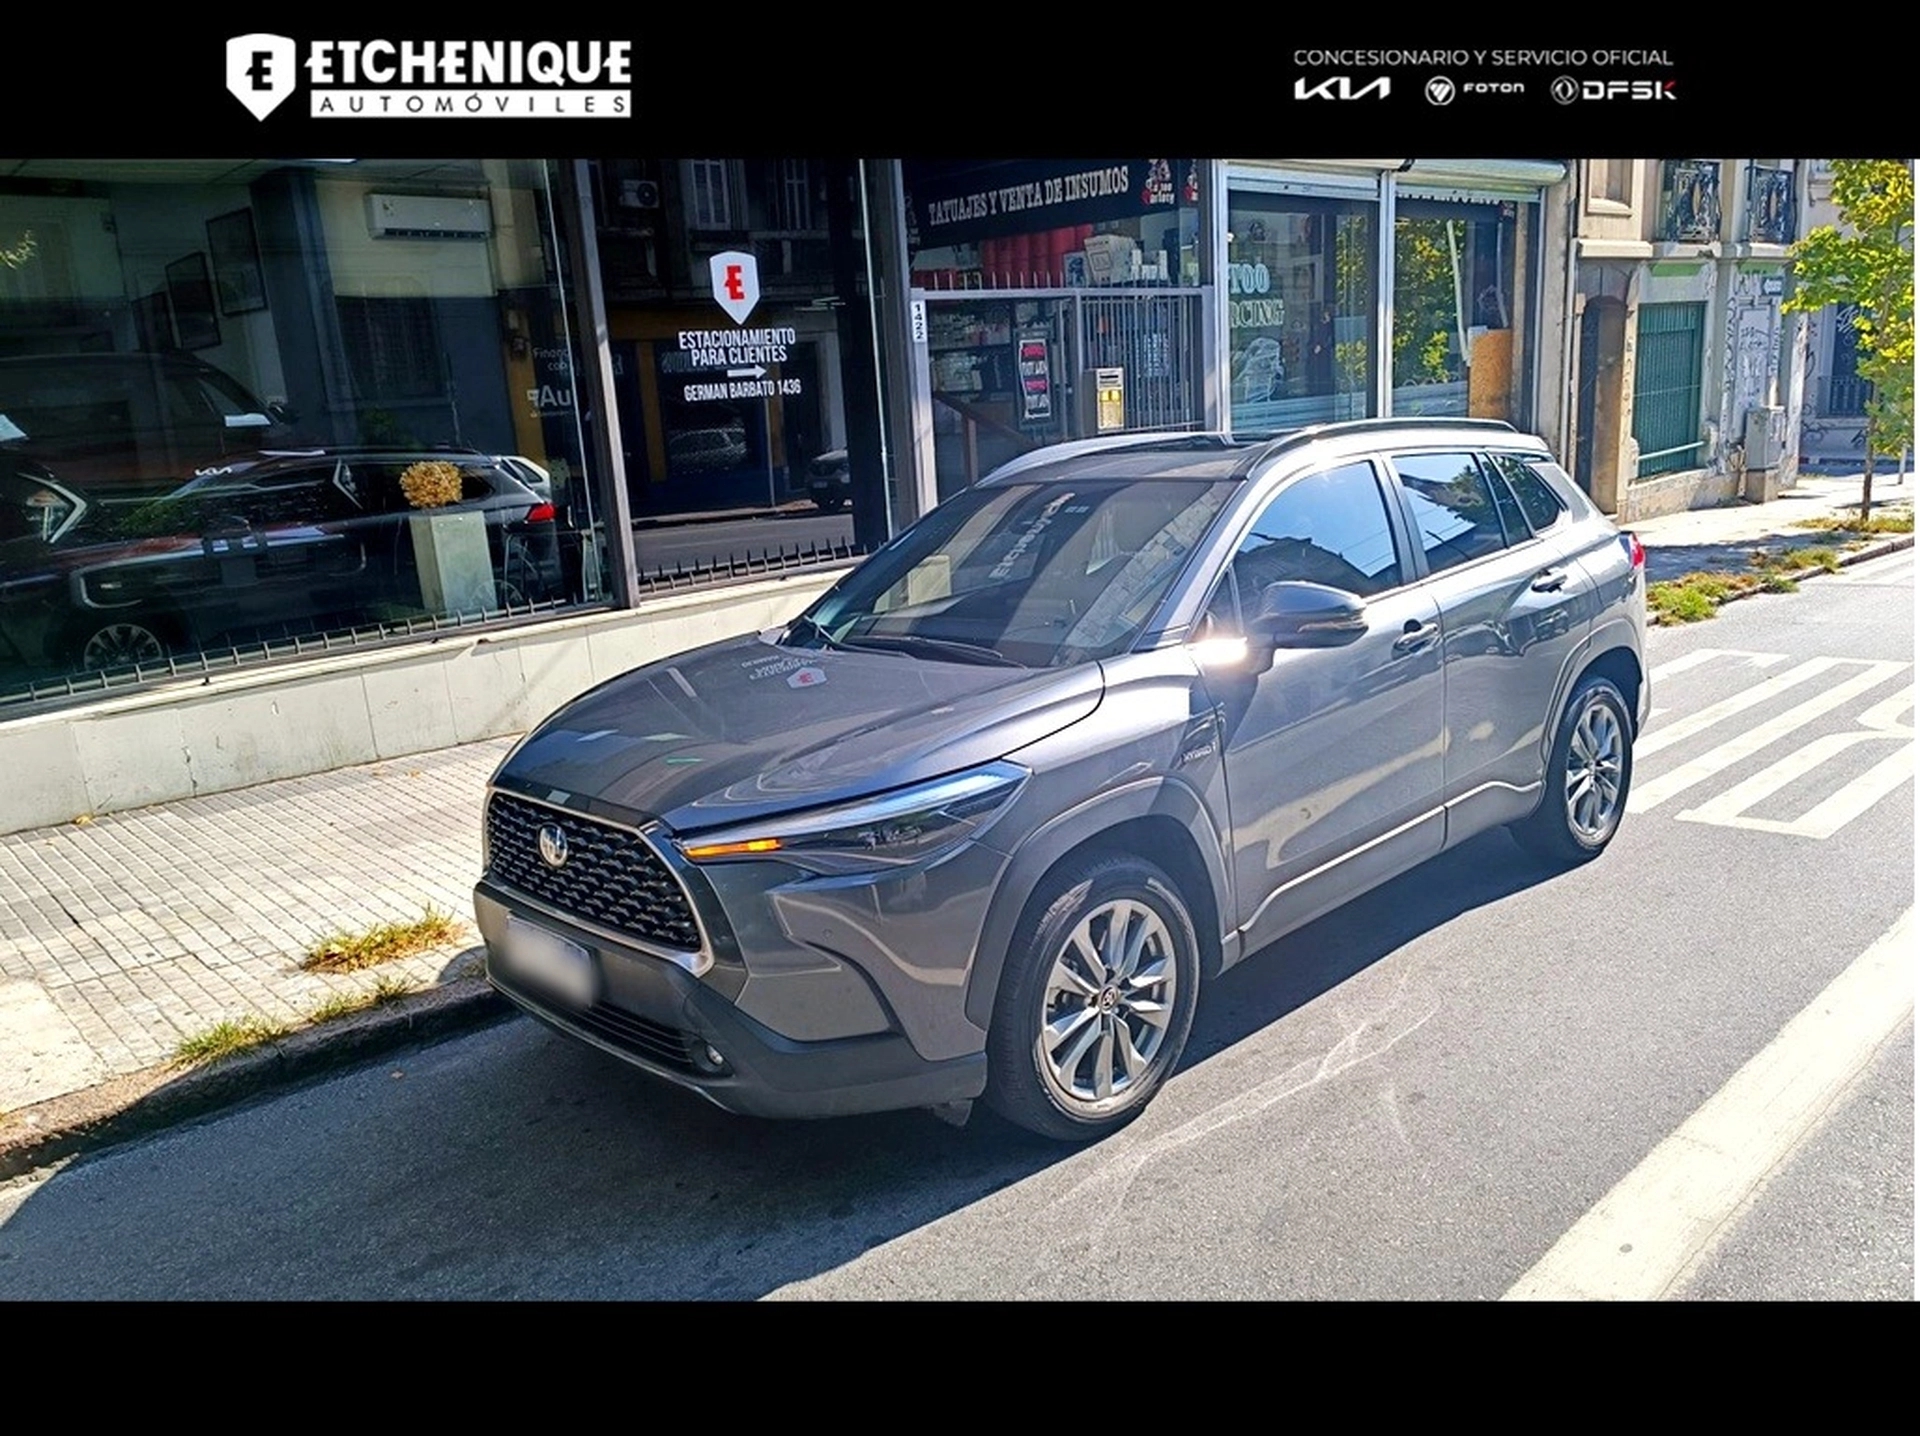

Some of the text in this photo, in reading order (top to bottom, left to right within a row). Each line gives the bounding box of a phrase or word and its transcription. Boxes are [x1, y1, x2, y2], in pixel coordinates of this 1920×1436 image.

[928, 192, 989, 226] TATUAJES
[1000, 182, 1043, 213] VENTA
[1045, 177, 1063, 205] DE
[1065, 165, 1129, 201] INSUMOS
[678, 328, 796, 349] ESTACIONAMIENTO
[691, 345, 788, 366] PARA CLIENTES
[684, 379, 801, 402] GERMAN BARBATO 1436
